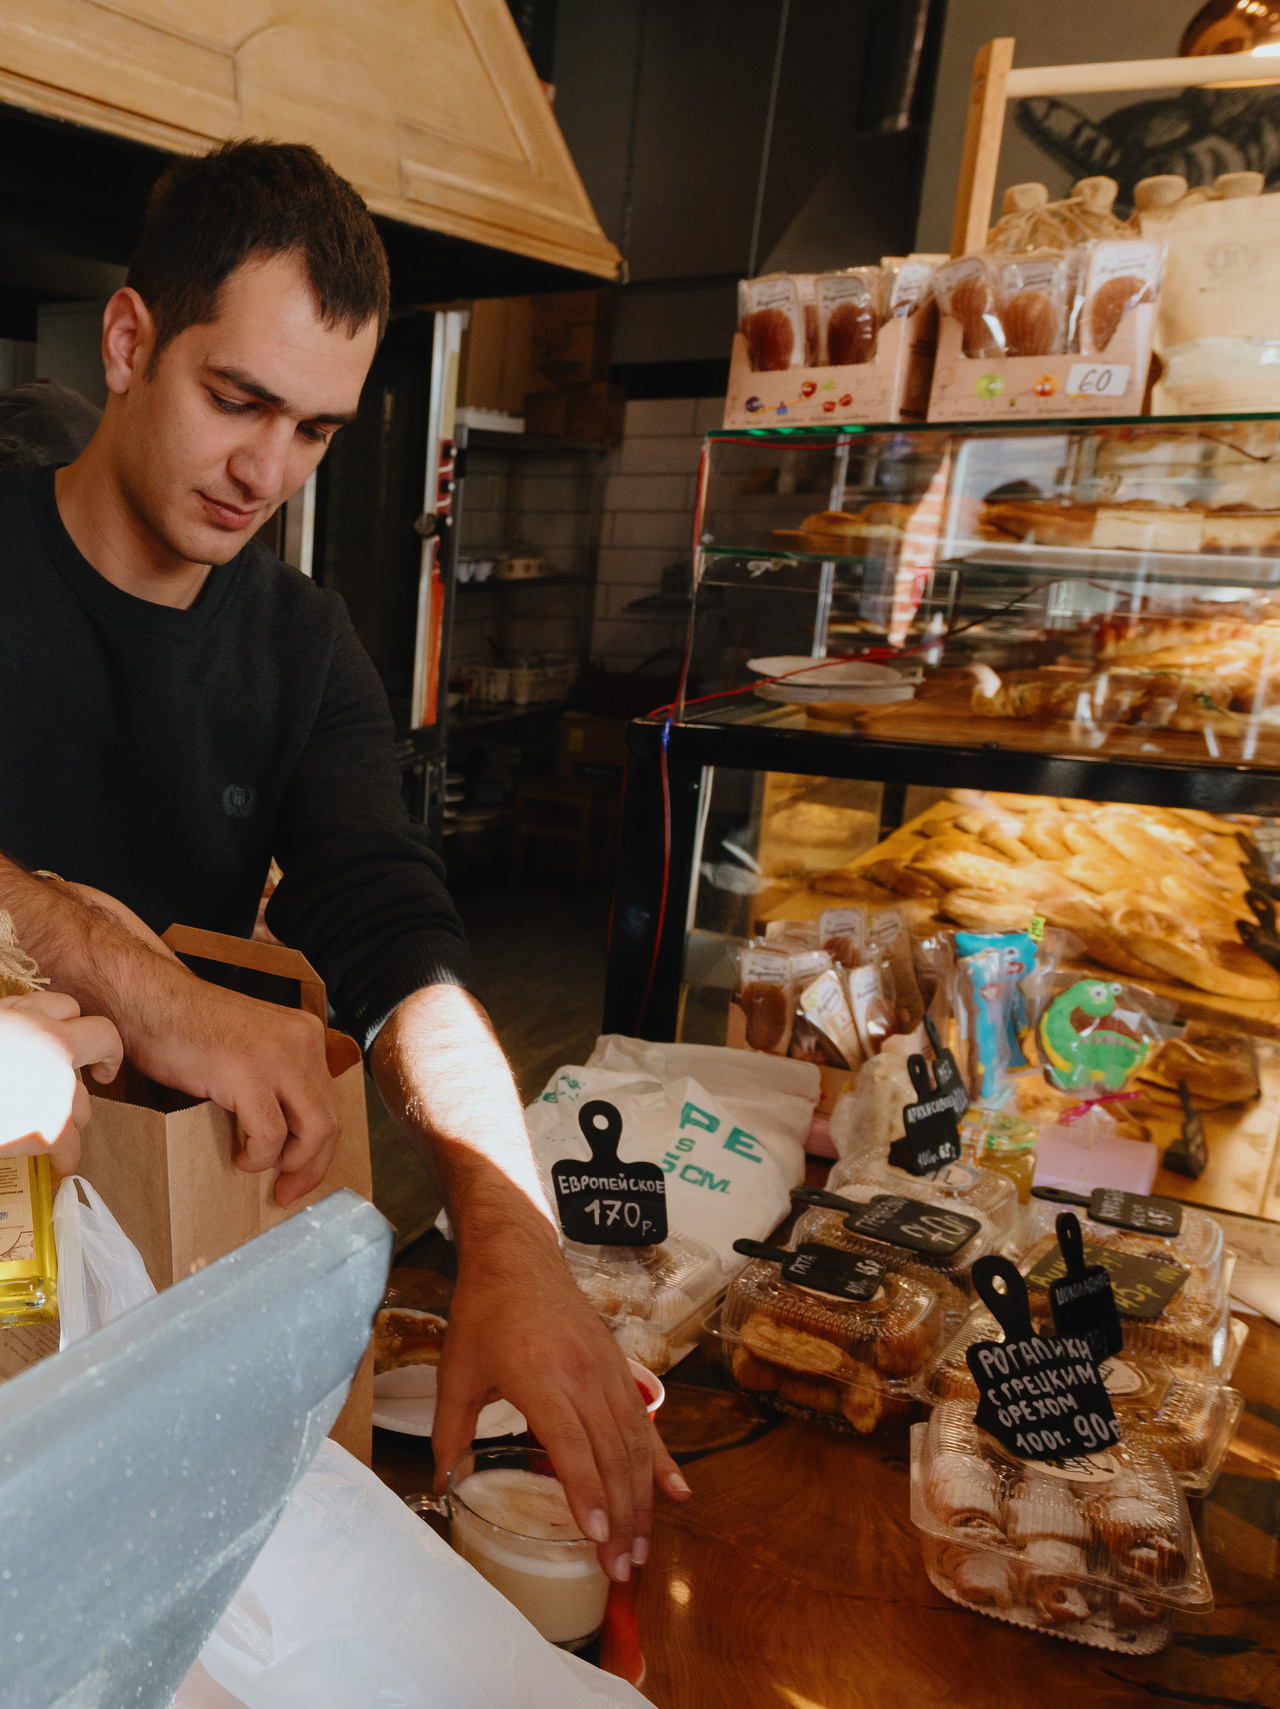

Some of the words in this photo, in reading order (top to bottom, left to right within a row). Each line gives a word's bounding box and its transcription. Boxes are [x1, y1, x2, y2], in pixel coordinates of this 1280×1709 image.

[1078, 369, 1113, 393] 60
[558, 1173, 665, 1195] ЕВРОПЕЙСКОЕ
[978, 1337, 1094, 1379] РОГАЛИКИ
[1001, 1362, 1097, 1400] ГРЕЦКИМ
[998, 1393, 1079, 1427] ОРЕХОМ
